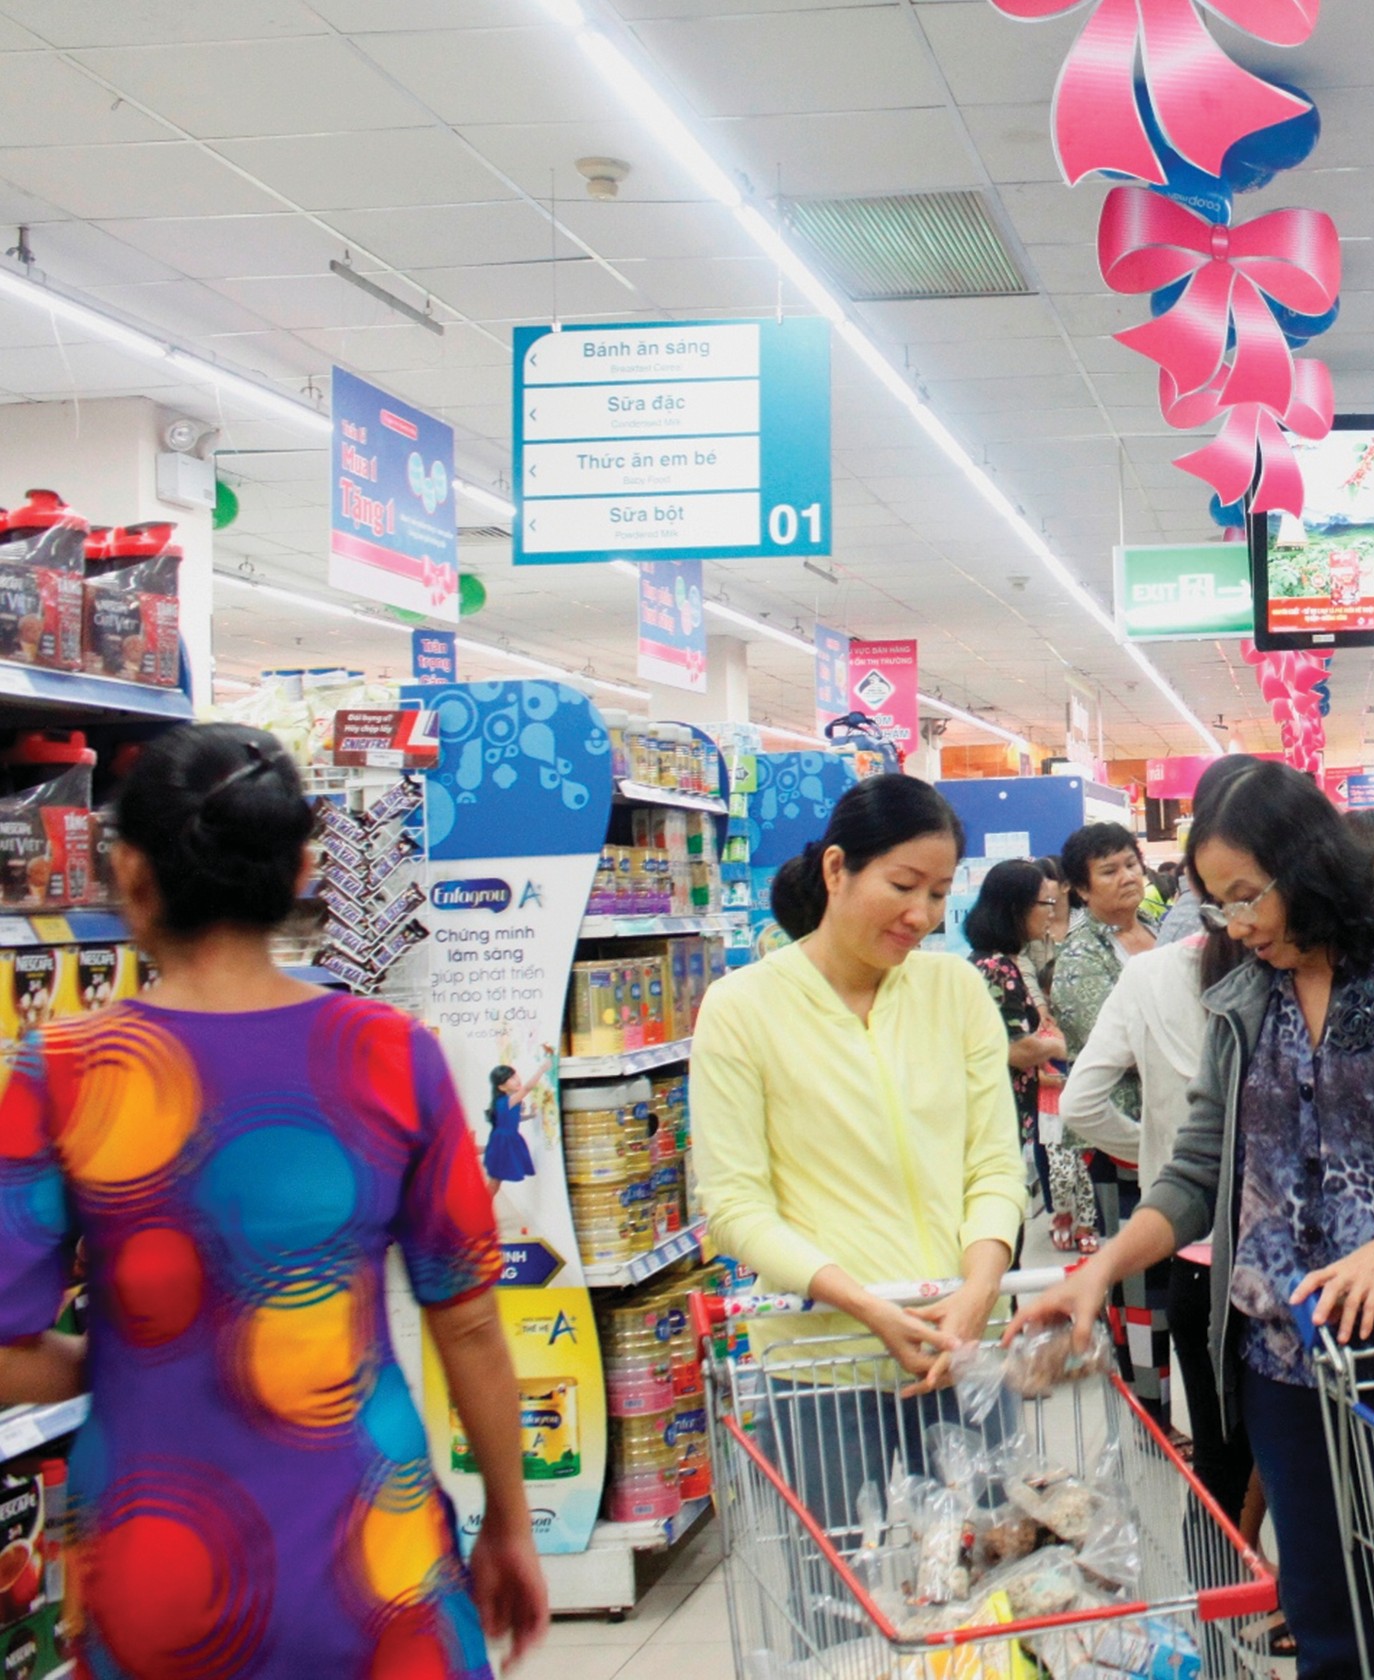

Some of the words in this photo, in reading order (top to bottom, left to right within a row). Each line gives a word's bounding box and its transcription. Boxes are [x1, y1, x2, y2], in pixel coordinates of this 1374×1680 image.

[583, 341, 631, 358] Bánh
[637, 341, 659, 356] ăn
[666, 339, 710, 357] sáng
[607, 396, 646, 412] Sữa
[651, 394, 685, 414] đặc
[577, 453, 625, 470] Thức
[631, 453, 654, 468] ăn
[660, 455, 688, 467] em
[694, 451, 717, 465] bé
[609, 506, 648, 523] Sữa
[654, 505, 684, 525] bột
[768, 503, 822, 545] 01
[1132, 583, 1177, 601] EXIT
[435, 928, 490, 944] Chứng
[495, 926, 535, 941] minh
[440, 1011, 480, 1027] ngay
